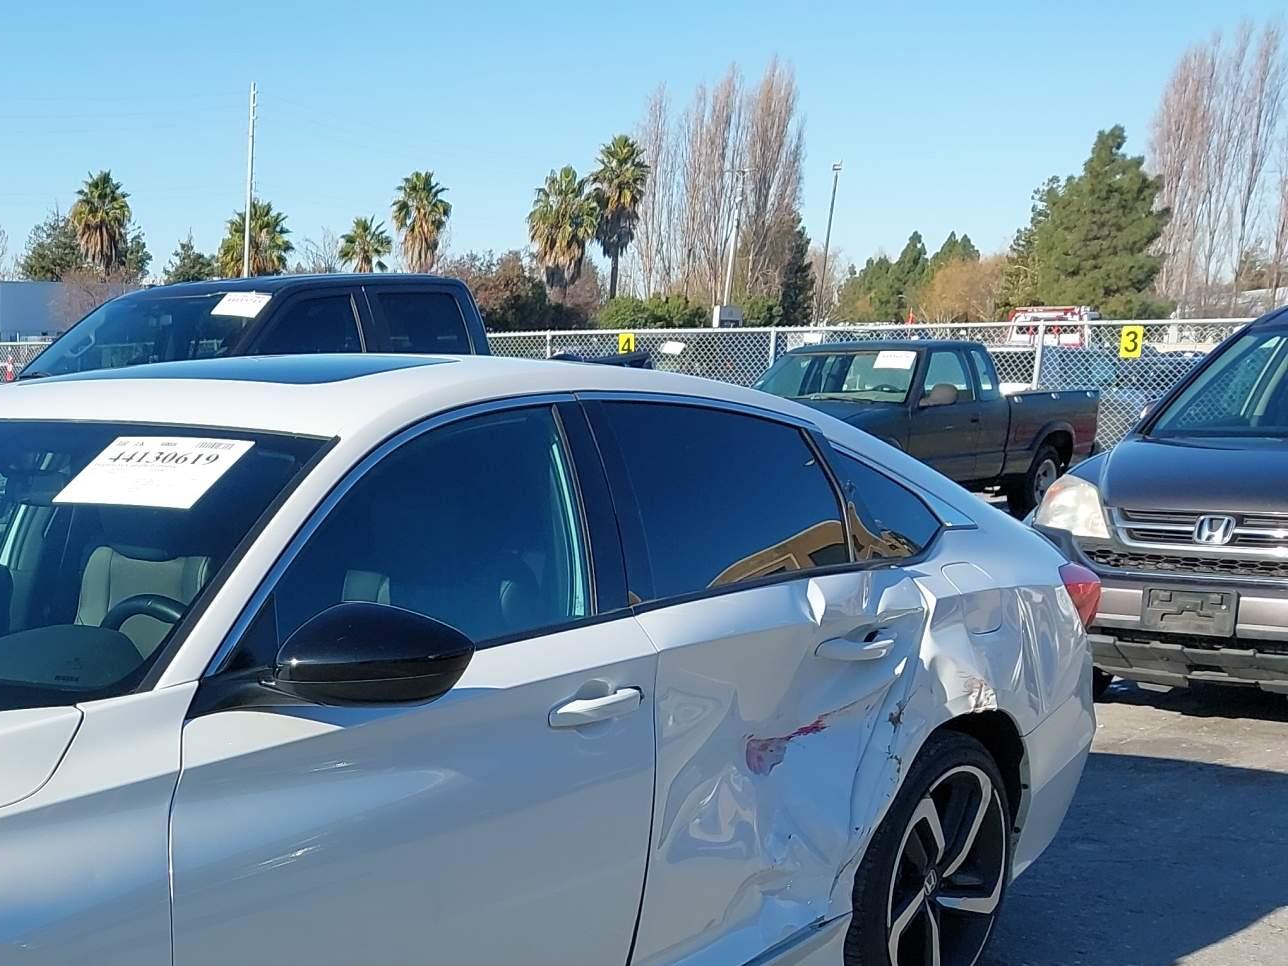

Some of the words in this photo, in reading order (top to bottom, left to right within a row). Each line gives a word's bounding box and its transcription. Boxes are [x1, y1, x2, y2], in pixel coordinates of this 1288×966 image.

[621, 337, 632, 352] 4
[1124, 330, 1138, 353] 3
[108, 450, 220, 466] 44130619
